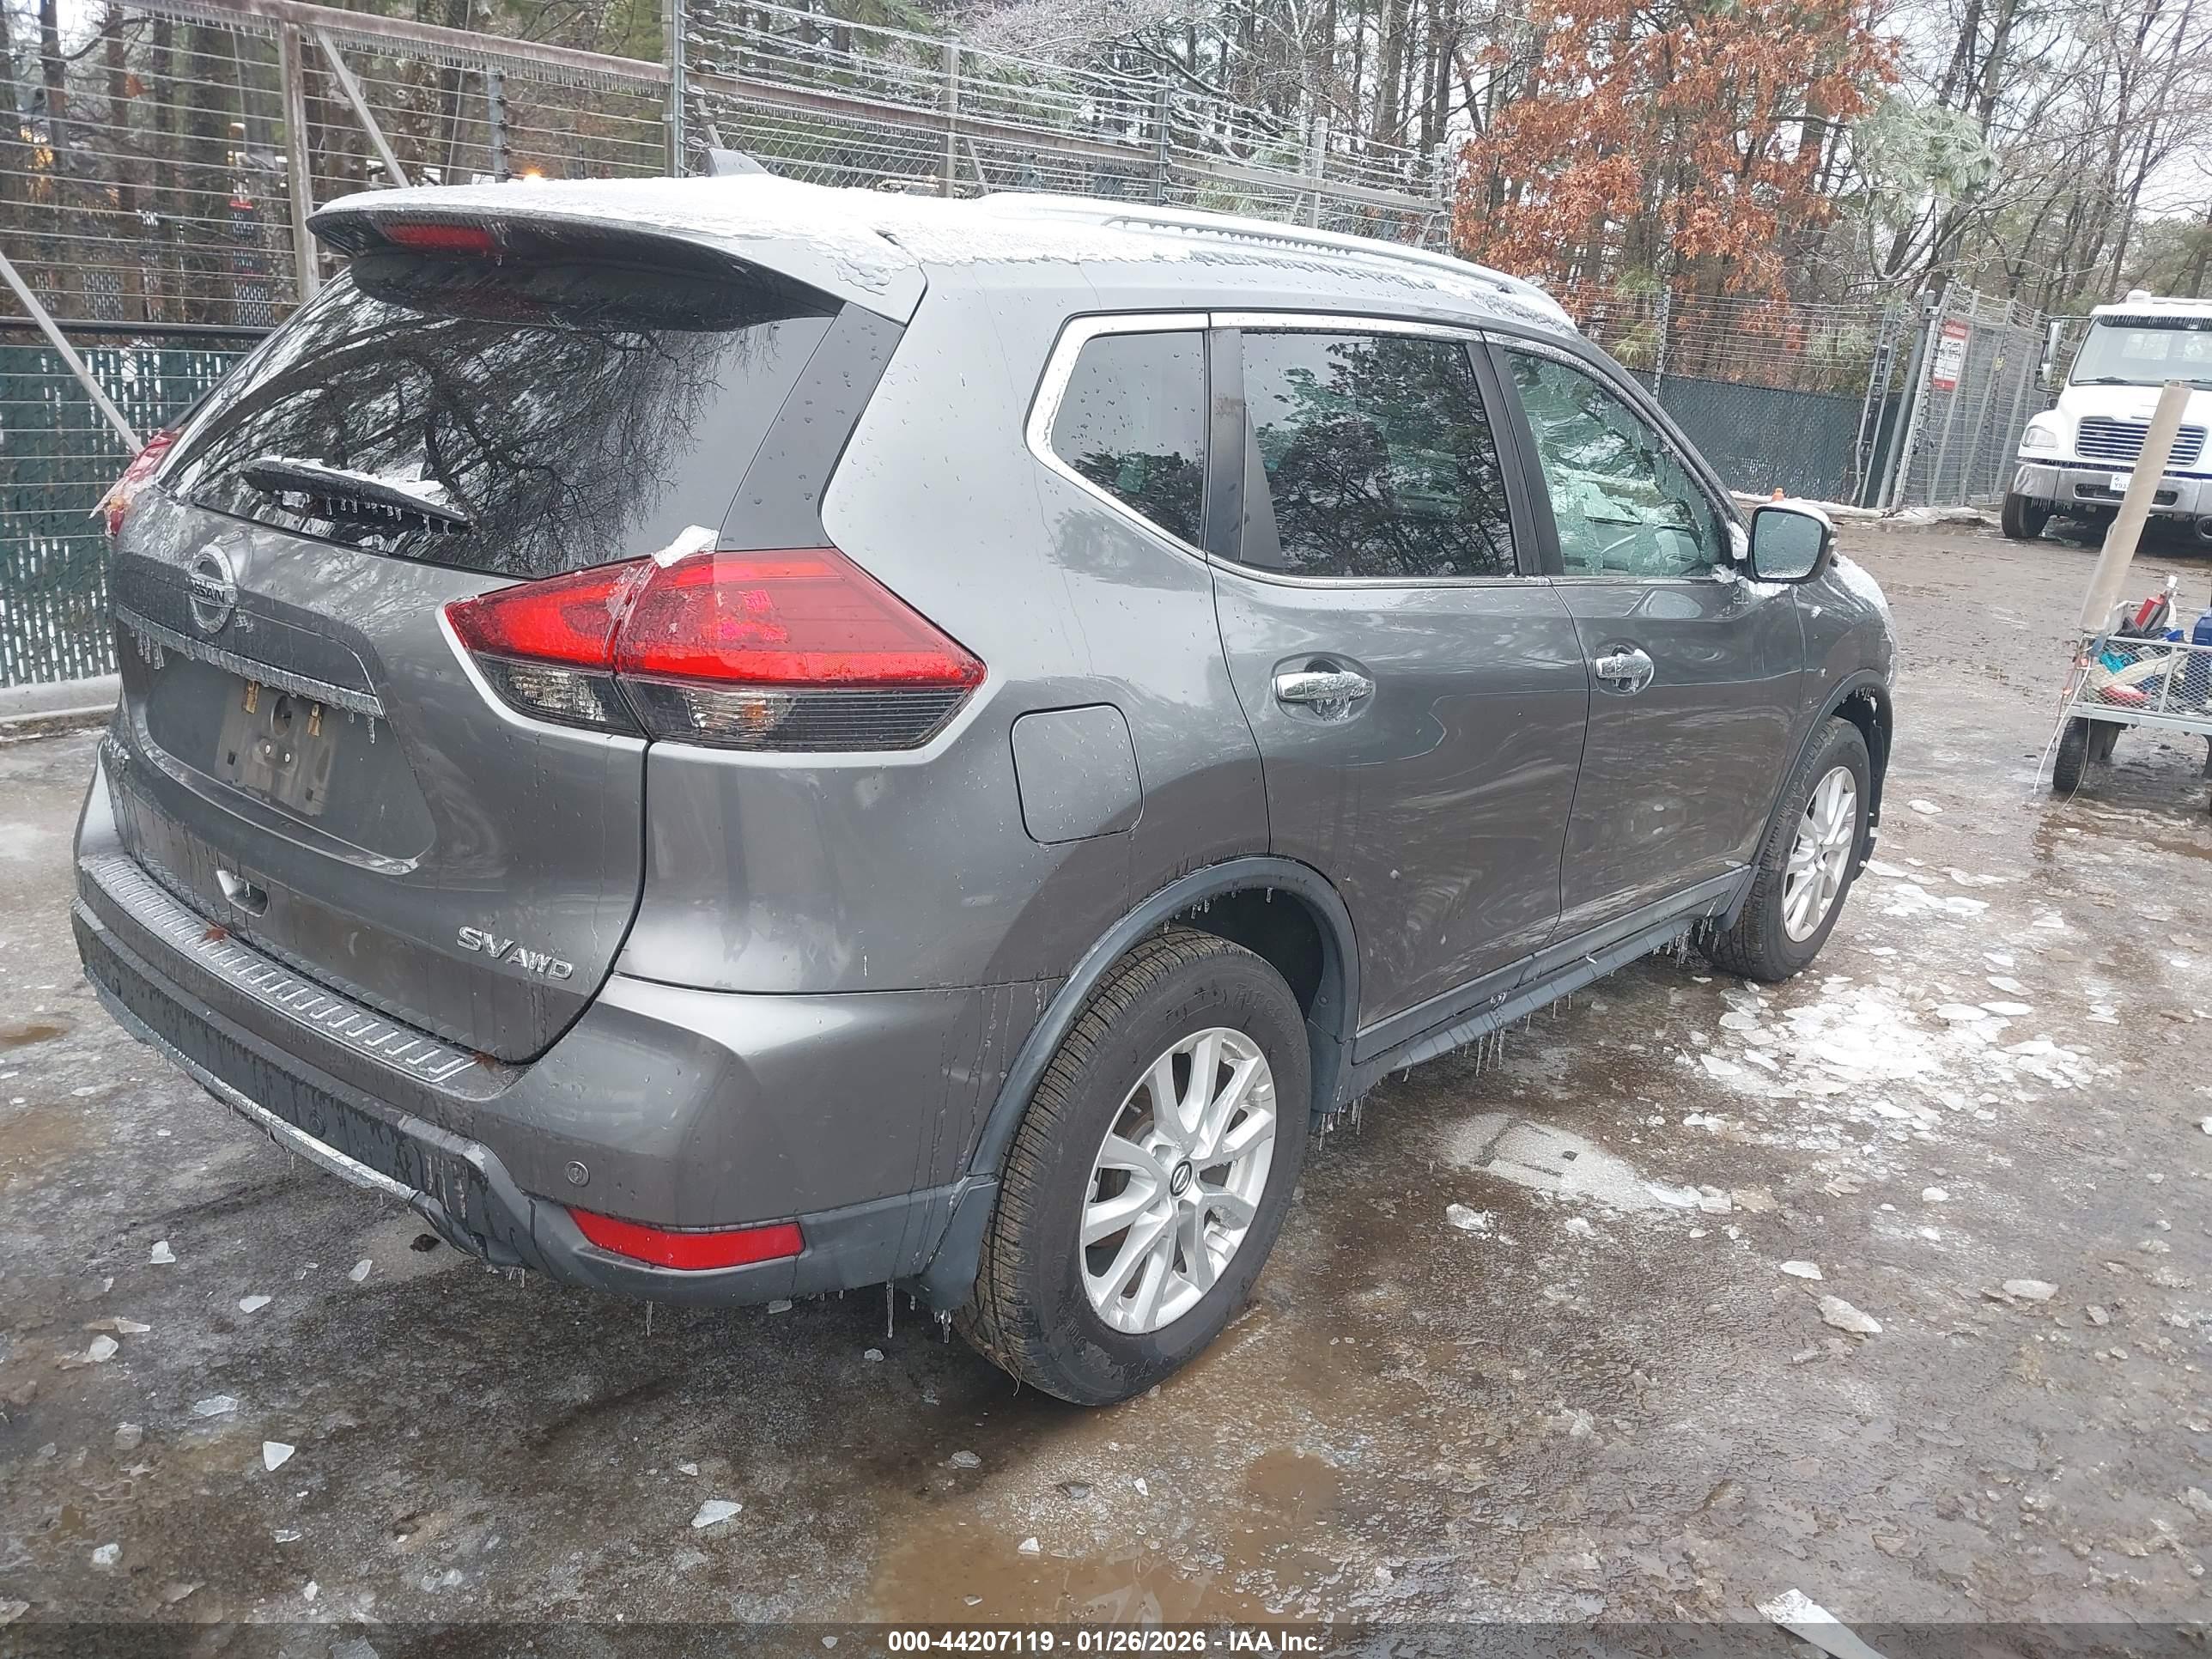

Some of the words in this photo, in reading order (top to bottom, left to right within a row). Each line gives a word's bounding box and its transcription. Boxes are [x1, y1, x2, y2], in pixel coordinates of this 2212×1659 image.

[192, 581, 226, 603] SSAN
[456, 926, 514, 959] SV
[506, 947, 574, 980] AWD
